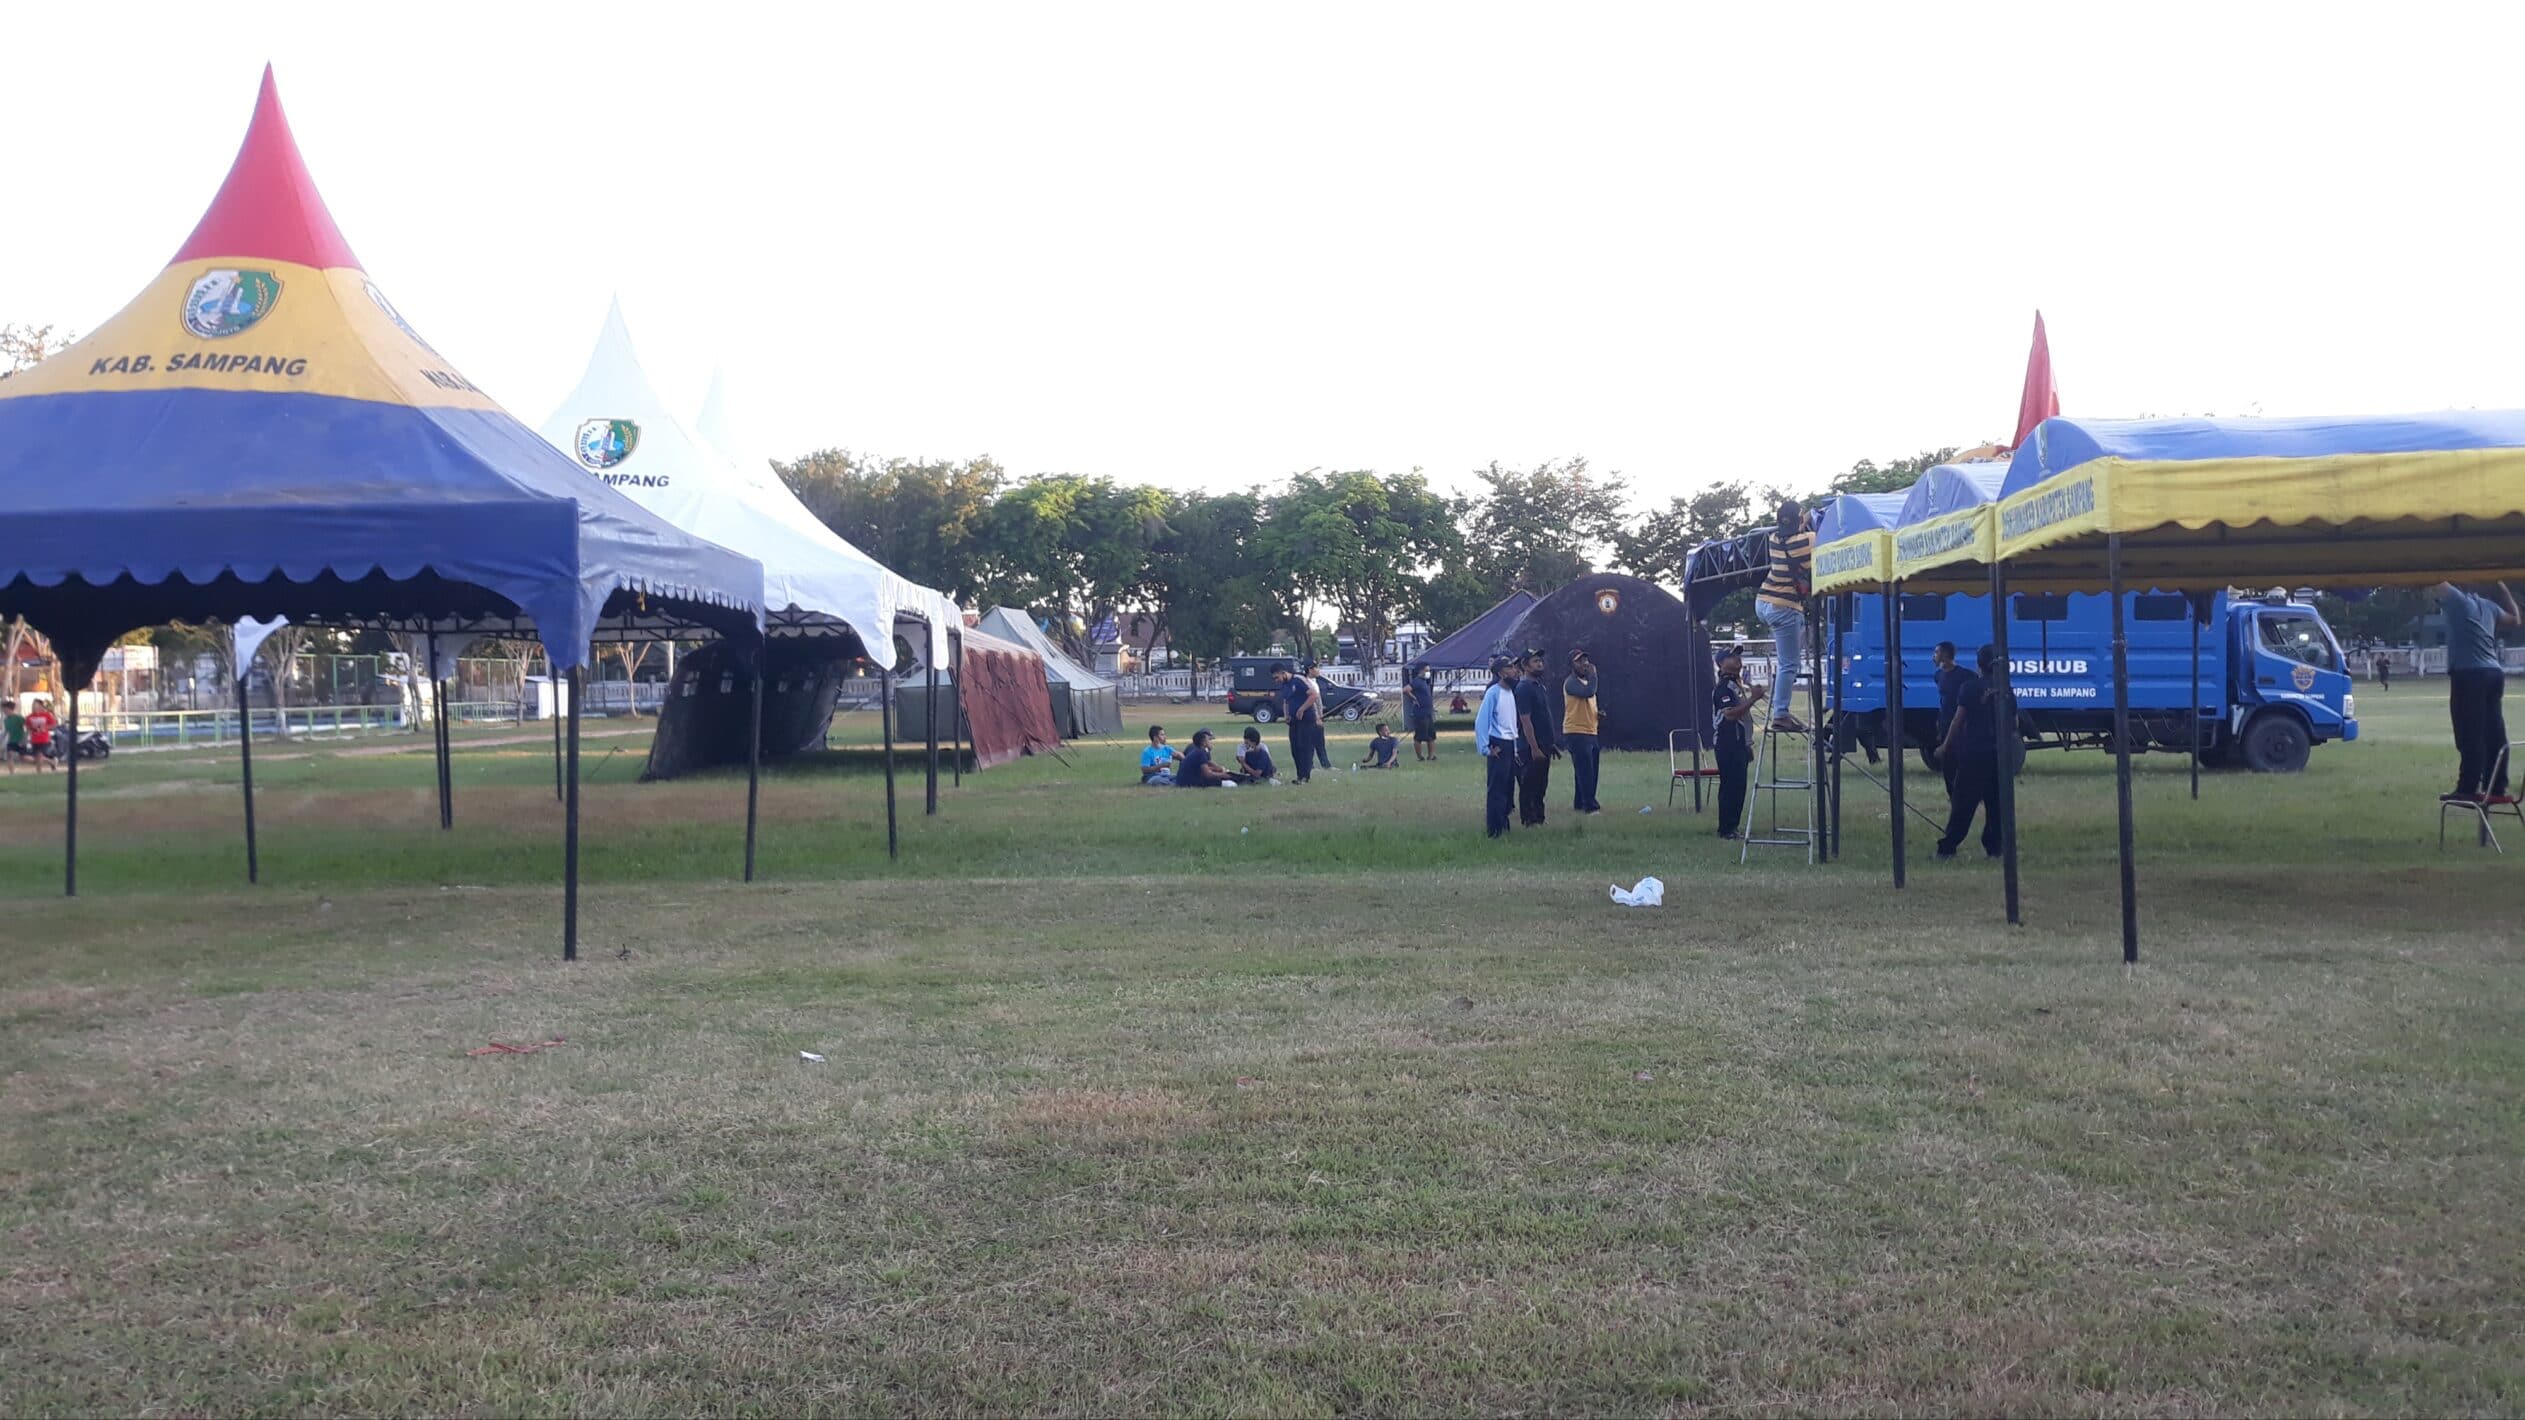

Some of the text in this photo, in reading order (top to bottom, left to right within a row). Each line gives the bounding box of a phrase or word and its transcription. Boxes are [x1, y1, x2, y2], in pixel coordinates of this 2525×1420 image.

[89, 353, 307, 376] KAB. SAMPANG
[2051, 687, 2096, 698] SAMPANG
